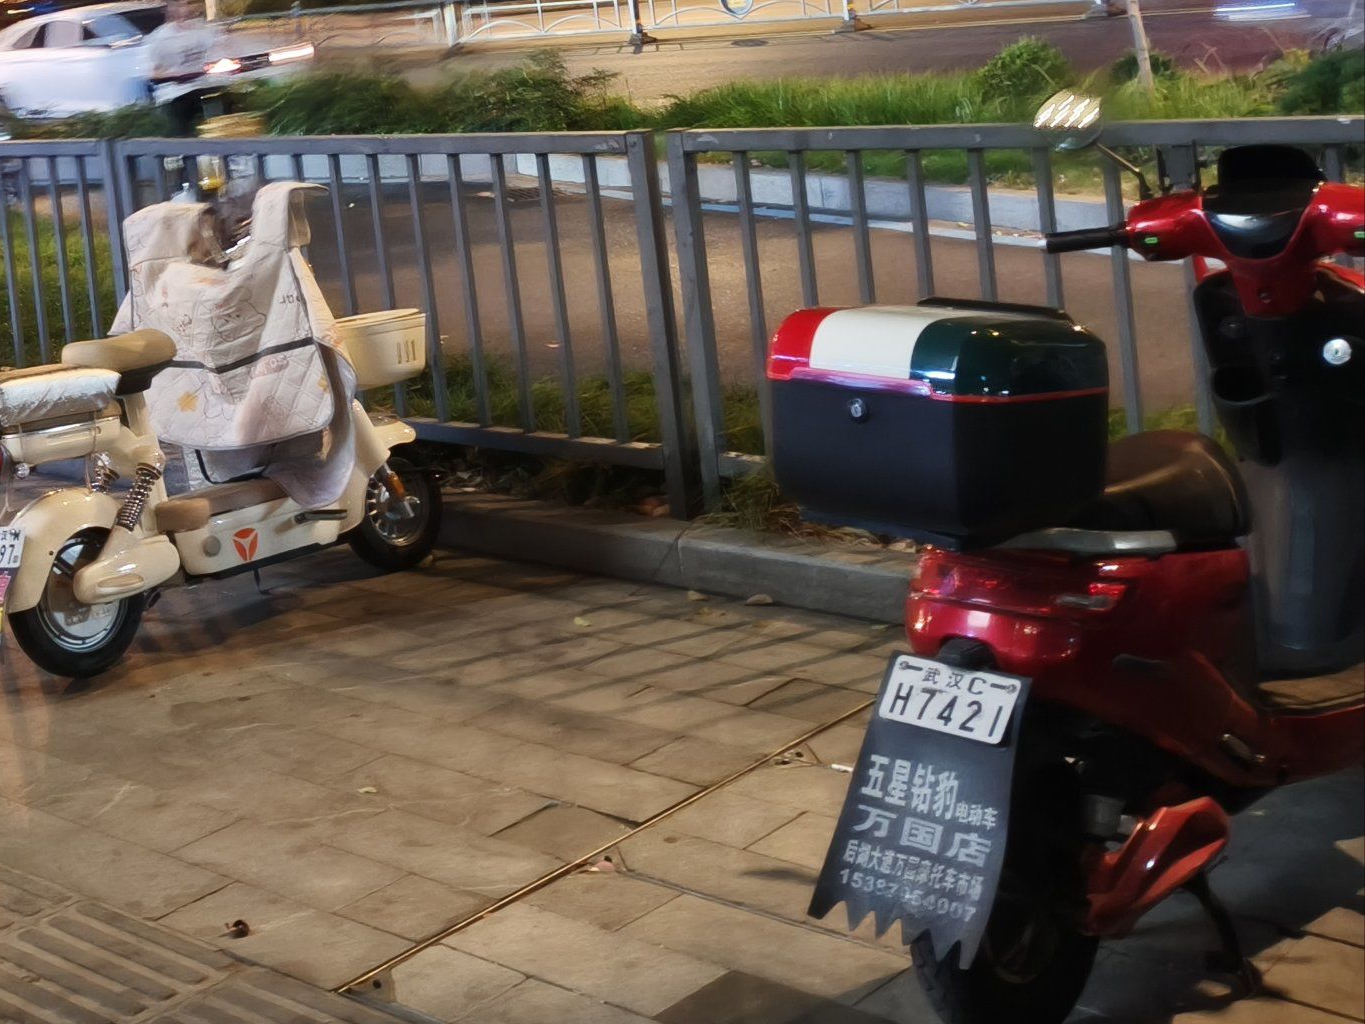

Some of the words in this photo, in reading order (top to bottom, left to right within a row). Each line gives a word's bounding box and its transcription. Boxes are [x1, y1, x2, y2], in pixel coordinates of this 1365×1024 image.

[888, 683, 1004, 737] H7421
[853, 804, 992, 868] 万国店
